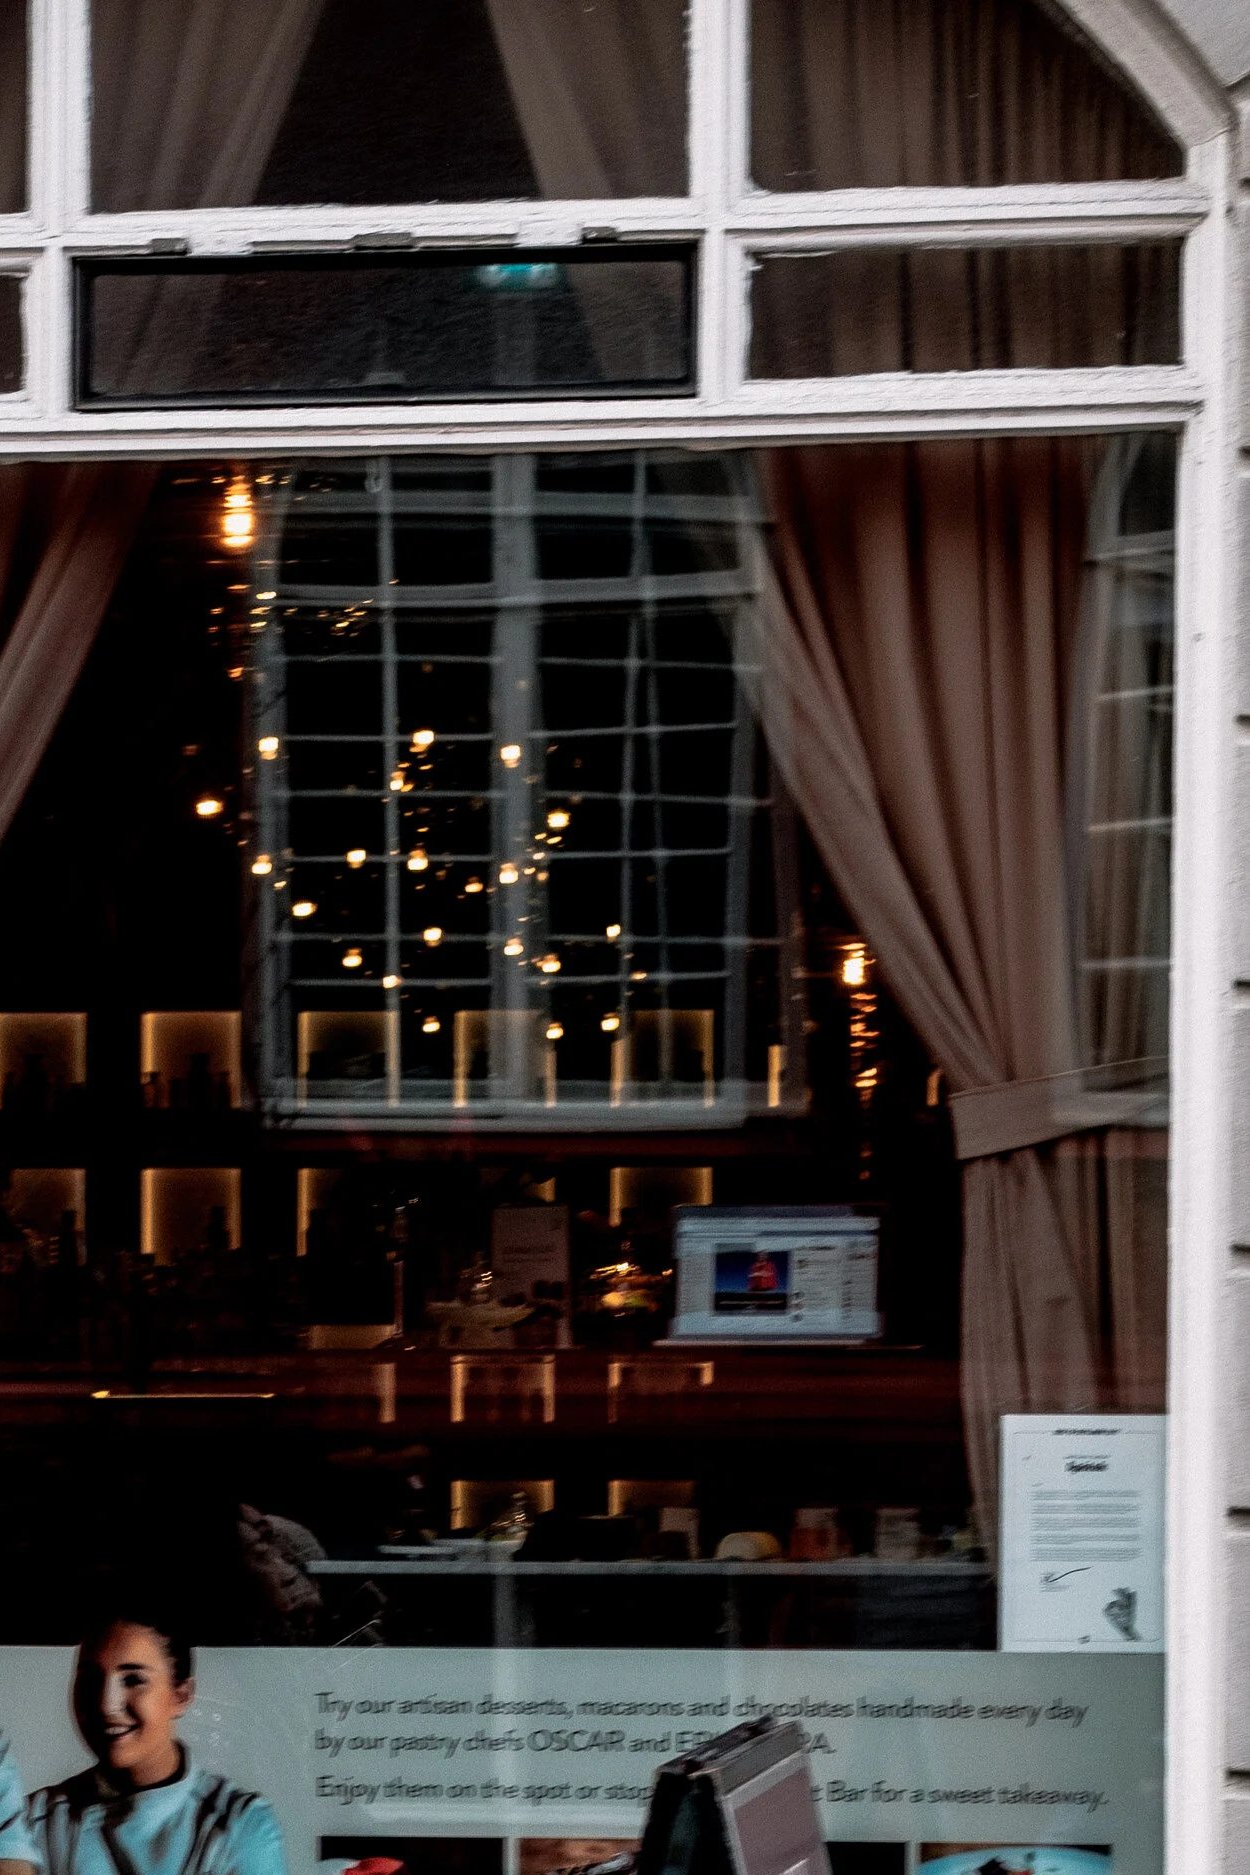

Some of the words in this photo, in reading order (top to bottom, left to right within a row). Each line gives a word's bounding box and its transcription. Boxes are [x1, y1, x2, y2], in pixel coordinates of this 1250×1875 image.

[315, 1692, 353, 1721] Try
[355, 1700, 396, 1714] our
[398, 1693, 473, 1714] artisan
[476, 1693, 573, 1720] desserts,
[576, 1701, 684, 1716] macarons
[687, 1696, 730, 1716] and
[733, 1695, 854, 1717] chocolates
[856, 1696, 975, 1718] handmade
[977, 1705, 1042, 1727] every
[1045, 1697, 1089, 1728] day
[315, 1728, 345, 1758] by
[347, 1736, 388, 1750] our
[390, 1734, 461, 1759] pastry
[527, 1729, 625, 1751] OSCAR
[628, 1731, 671, 1752] and
[315, 1775, 381, 1805] Enjoy
[383, 1777, 443, 1797] them
[445, 1785, 477, 1797] on
[480, 1778, 519, 1798] the
[522, 1782, 571, 1806] spot
[575, 1785, 602, 1799] or
[826, 1780, 869, 1802] Bar
[871, 1780, 908, 1802] for
[909, 1789, 924, 1803] a
[928, 1787, 994, 1803] sweet
[997, 1782, 1109, 1814] takeaway.
